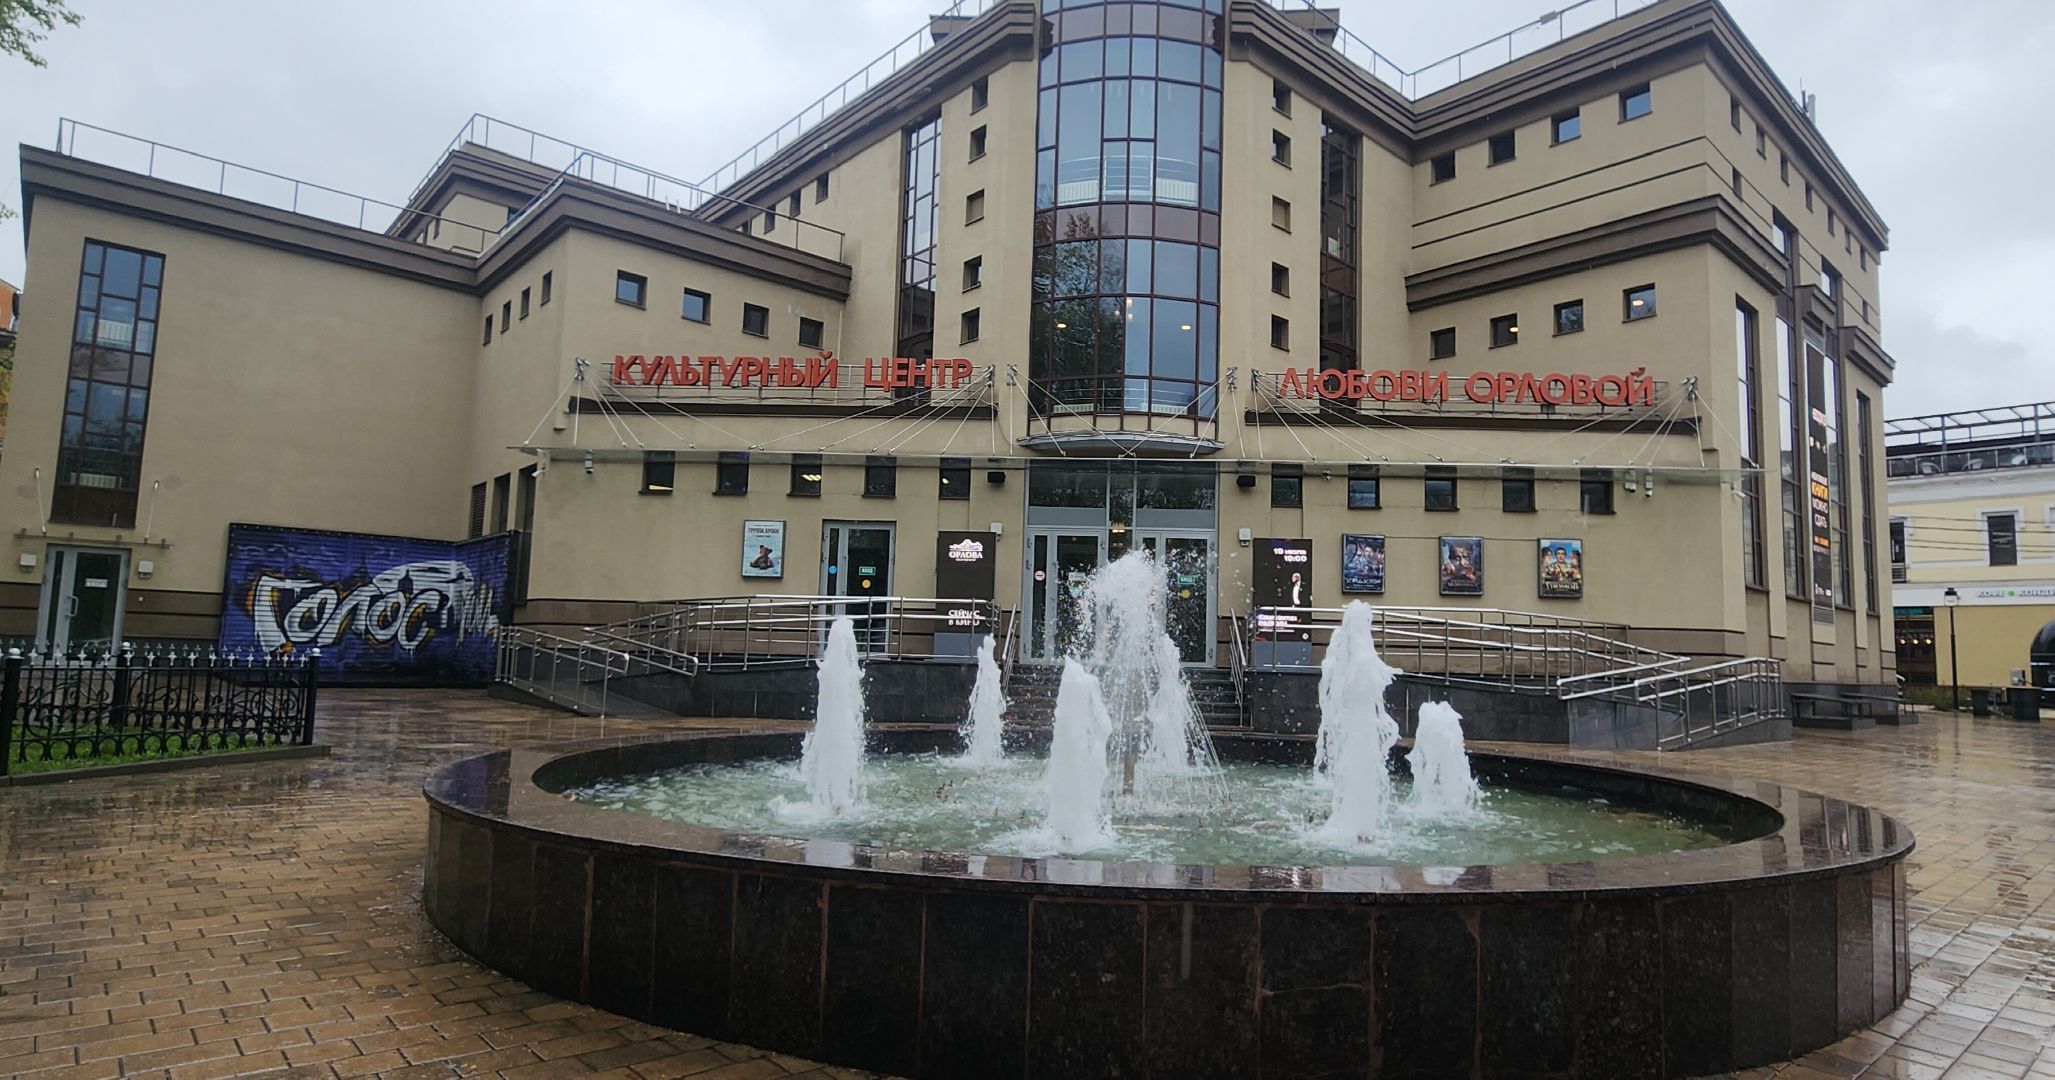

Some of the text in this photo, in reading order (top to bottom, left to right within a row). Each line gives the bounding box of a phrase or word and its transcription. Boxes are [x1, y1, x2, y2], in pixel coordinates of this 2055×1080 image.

[612, 352, 973, 392] КУЛЬТУРНЫЙ ЦЕНТР
[1279, 367, 1655, 406] ЛЮБОВИ ОРЛОВОЙ
